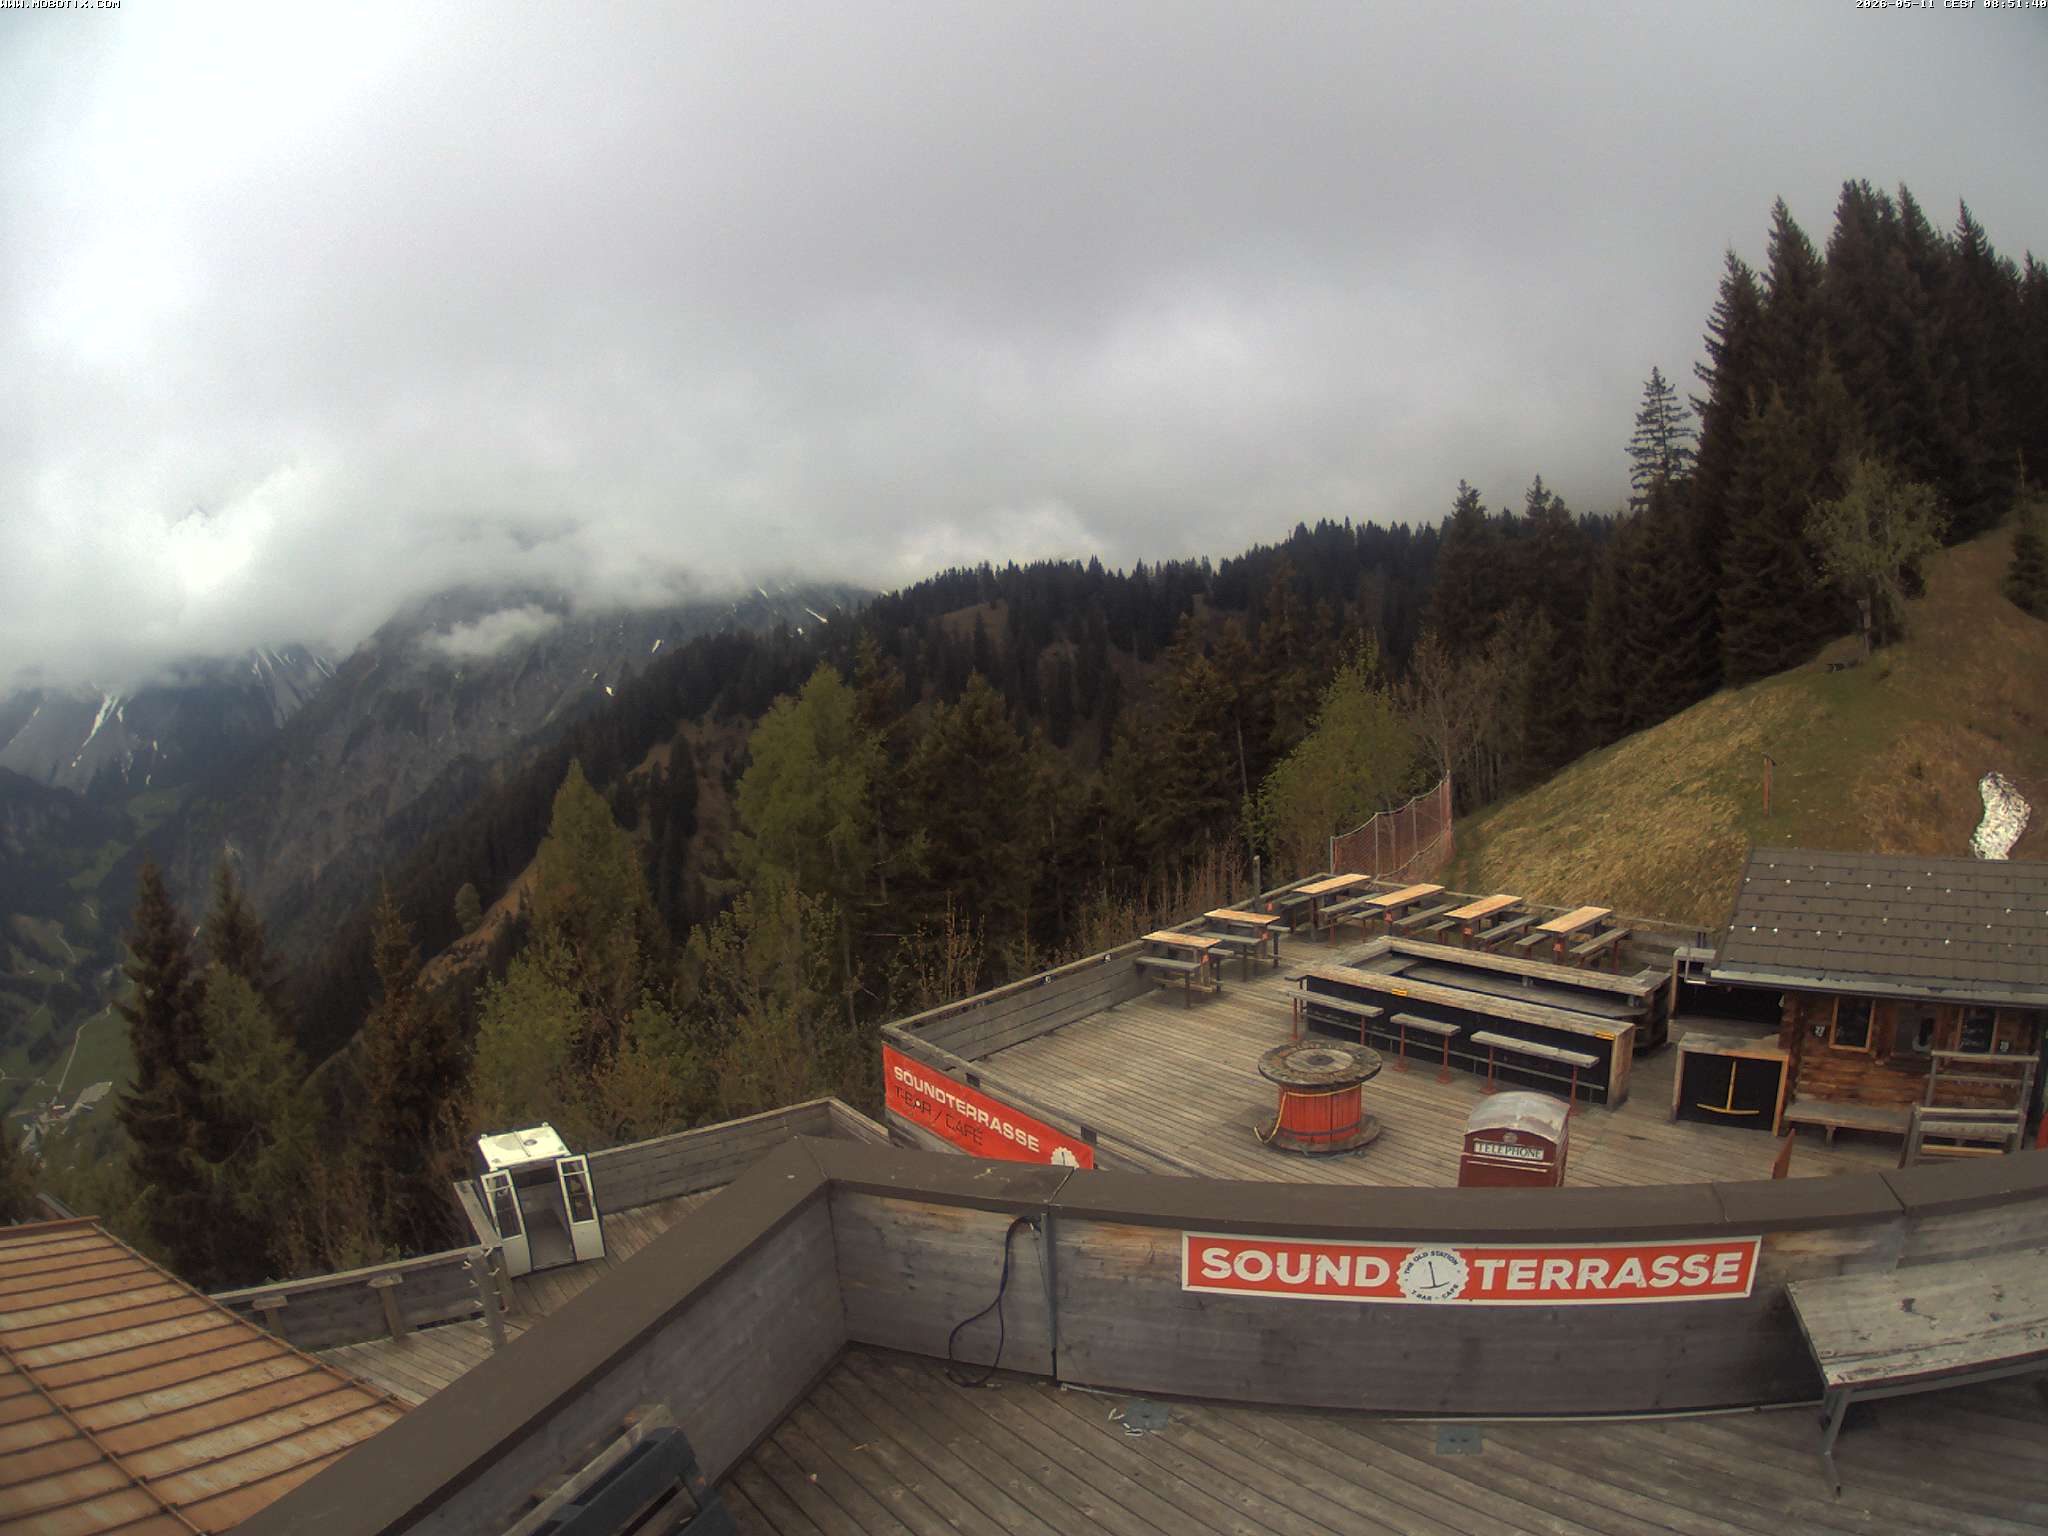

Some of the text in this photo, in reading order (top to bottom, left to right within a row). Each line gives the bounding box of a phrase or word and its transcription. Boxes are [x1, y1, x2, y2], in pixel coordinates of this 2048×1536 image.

[893, 1065, 1041, 1153] SOUNDTERRASSE
[1477, 1142, 1541, 1158] TELEPHONE
[1200, 1247, 1743, 1290] SOUND TERRASSE
[1404, 1250, 1458, 1274] THE OLD STATION
